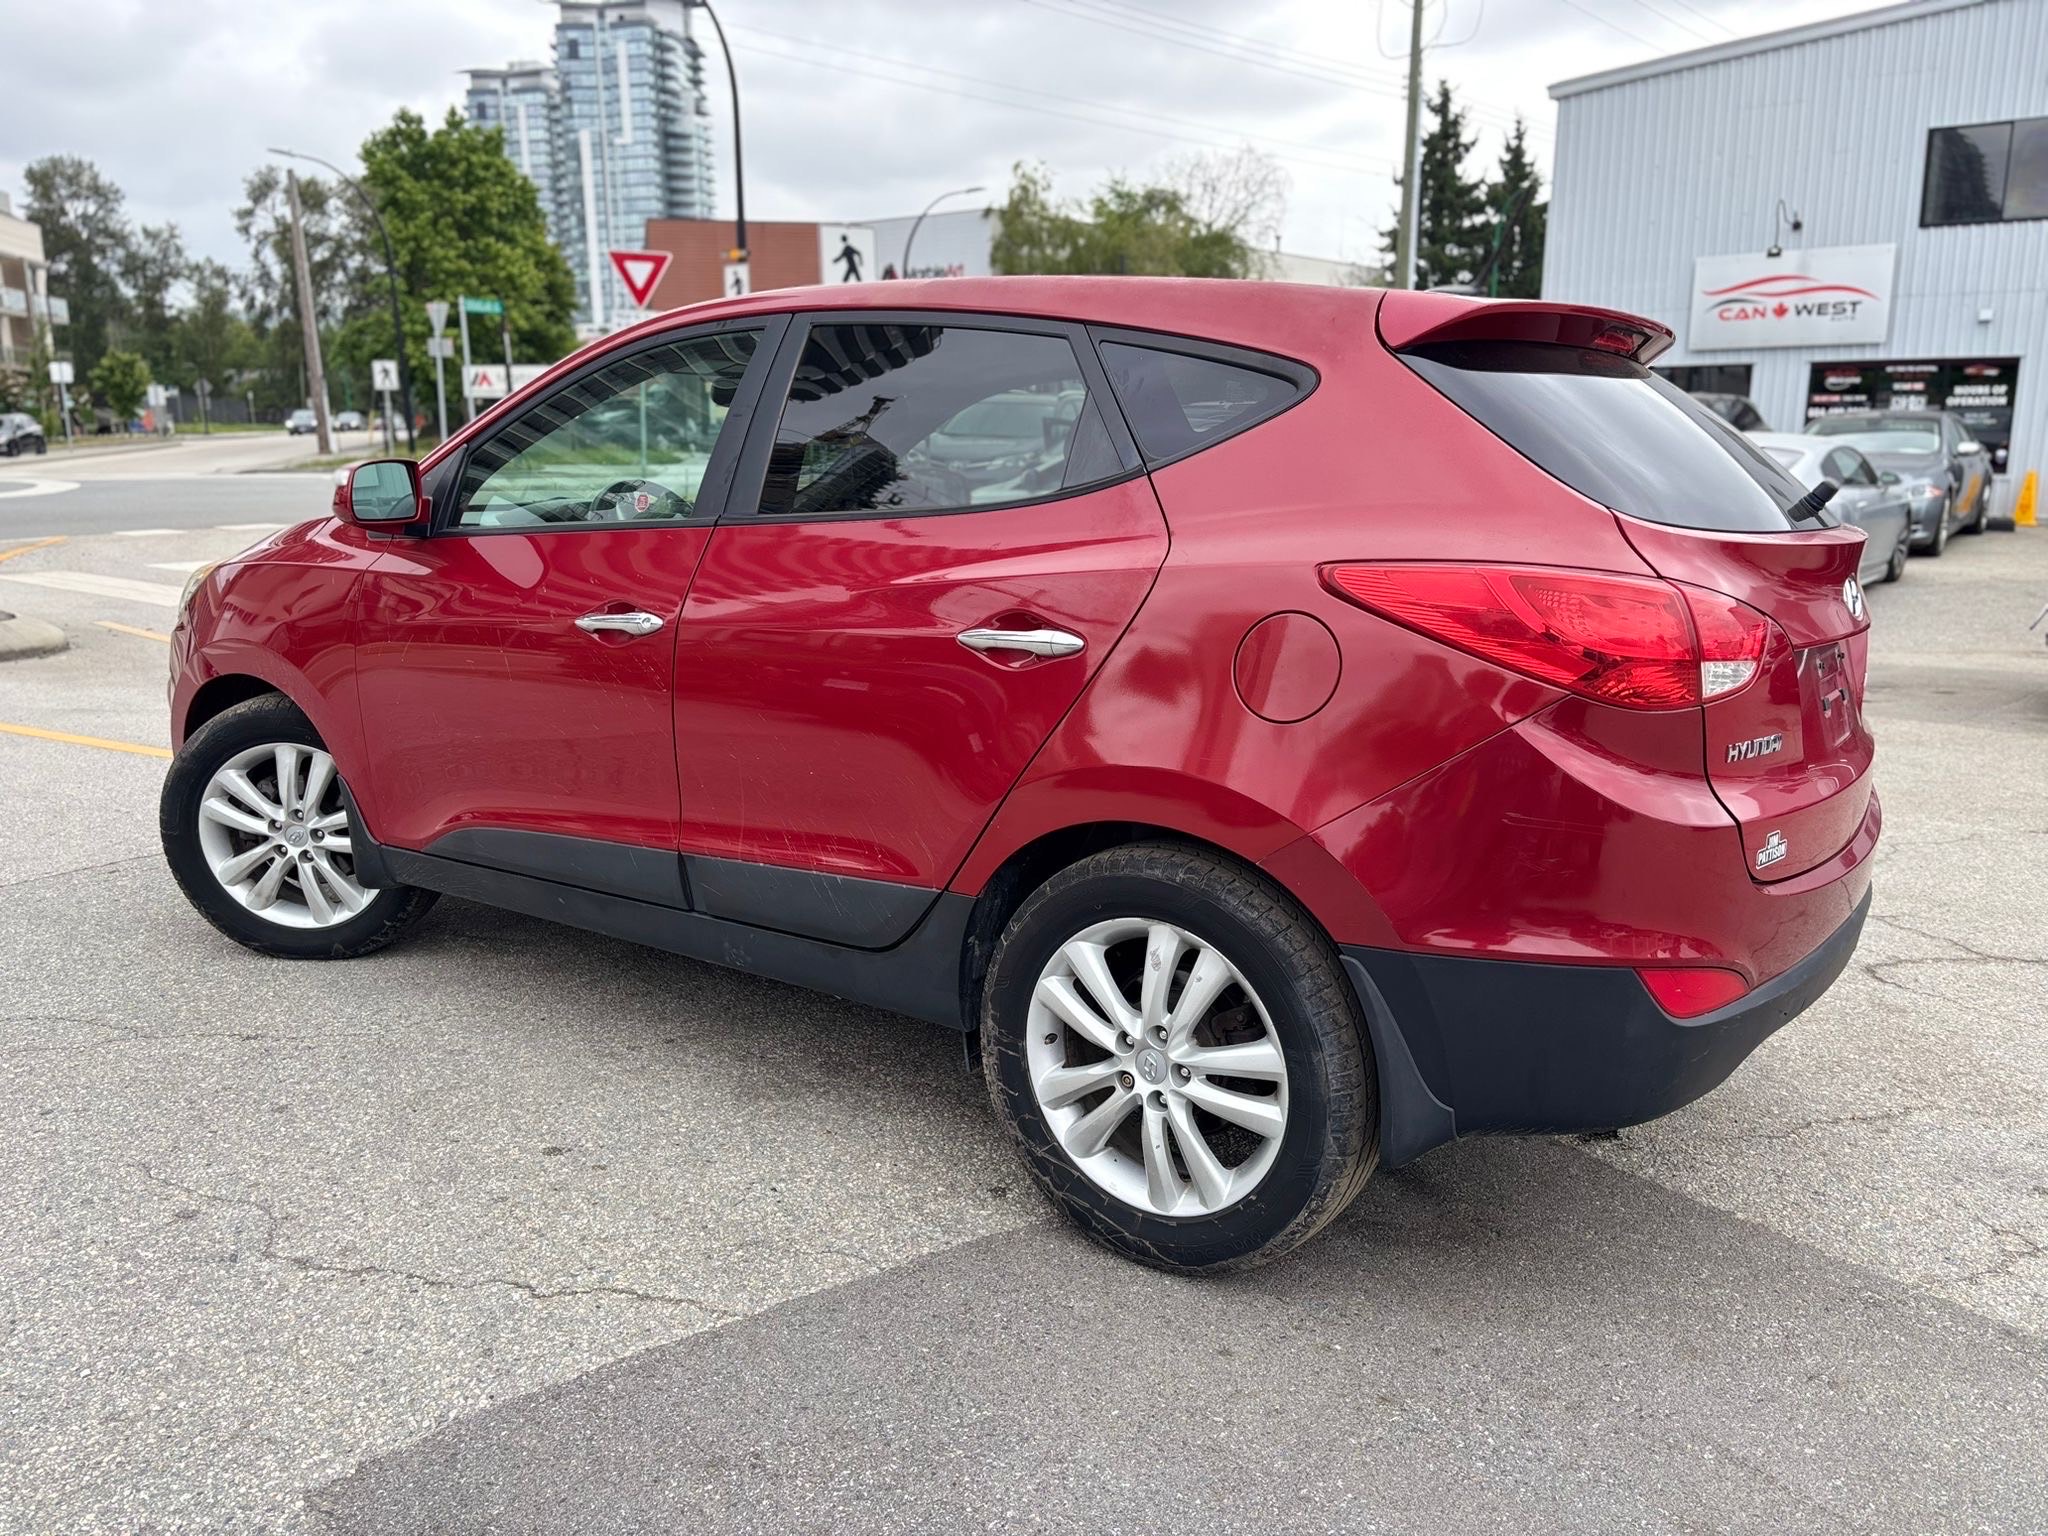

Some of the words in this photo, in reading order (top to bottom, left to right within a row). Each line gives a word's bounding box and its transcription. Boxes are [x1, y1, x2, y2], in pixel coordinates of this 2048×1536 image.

[1717, 306, 1767, 322] CAN
[1794, 300, 1863, 317] WEST
[1953, 384, 1990, 396] HOURS
[1991, 383, 2009, 396] OF
[1945, 395, 2008, 407] OPERATION
[1725, 733, 1782, 763] HYUNDAI
[1767, 833, 1779, 849] JIM
[1758, 843, 1787, 866] PATTISON
